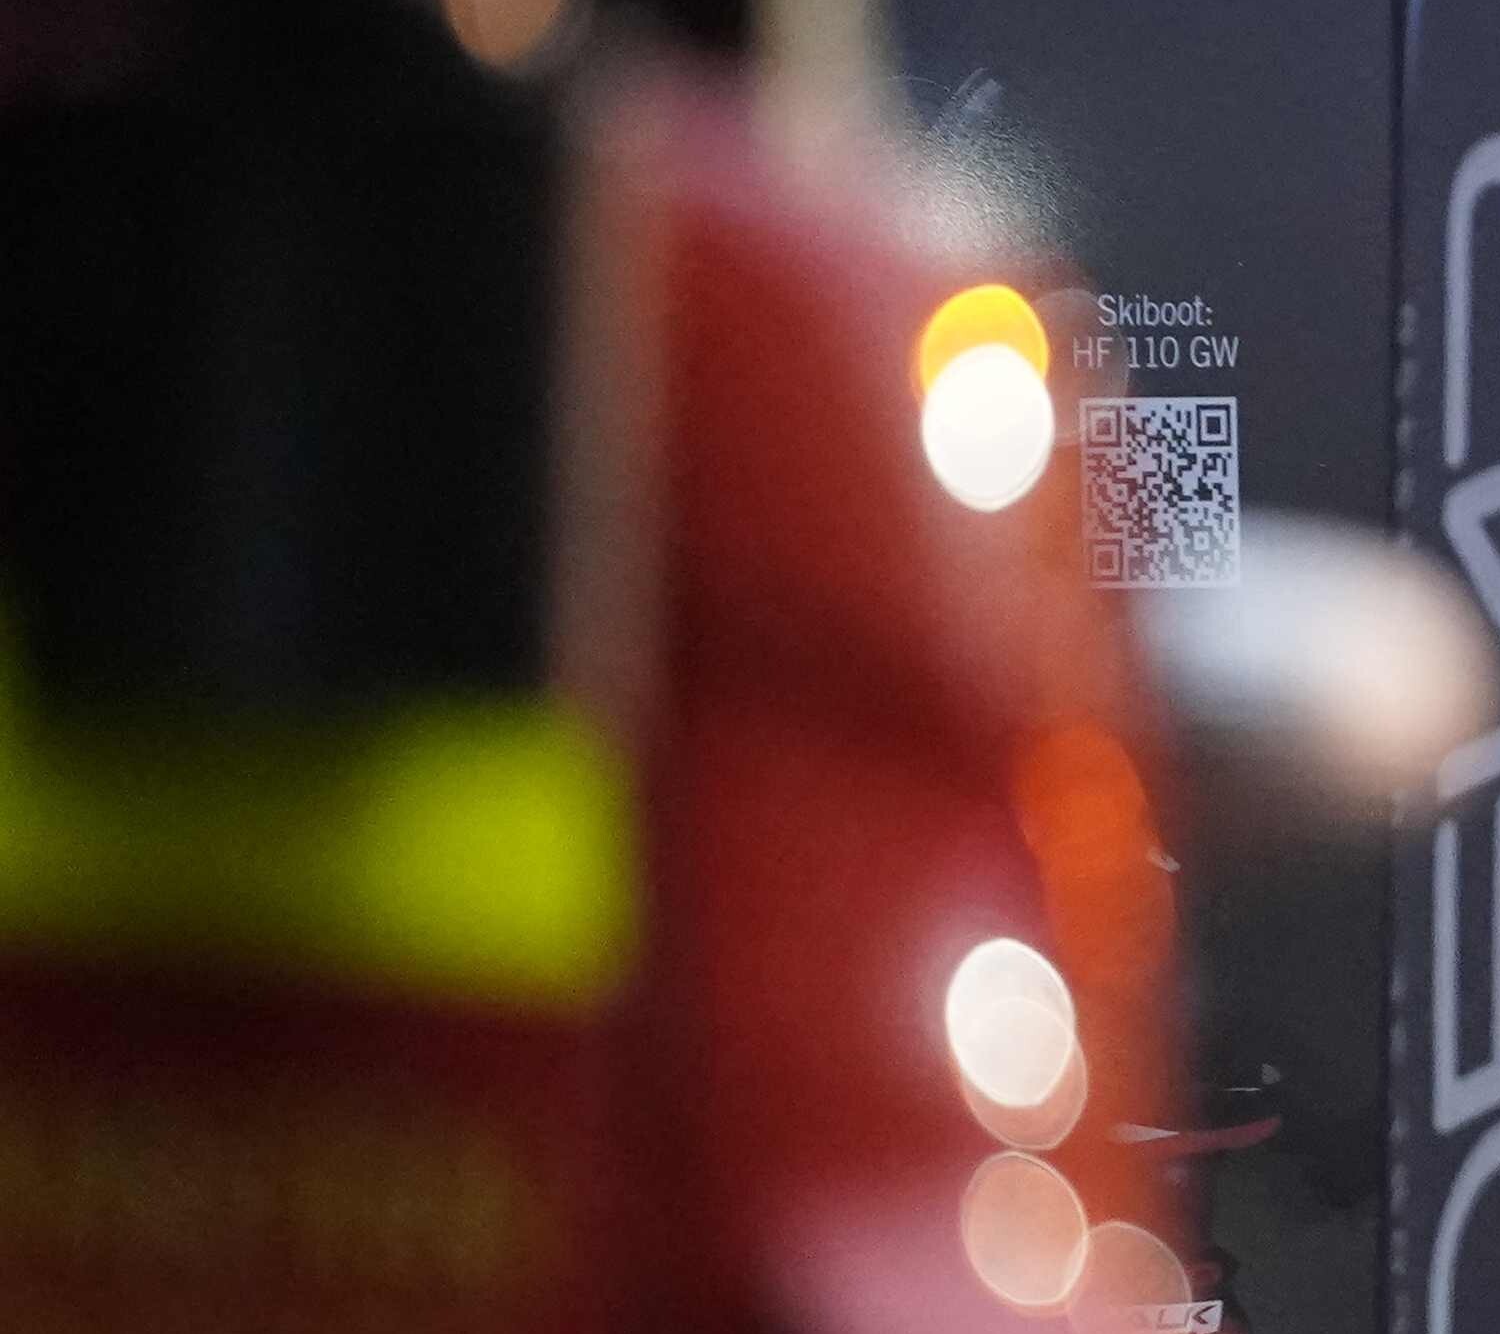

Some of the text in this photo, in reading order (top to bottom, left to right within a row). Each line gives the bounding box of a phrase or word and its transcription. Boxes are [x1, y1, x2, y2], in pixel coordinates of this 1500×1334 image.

[1099, 294, 1212, 326] Skiboot:
[1073, 335, 1240, 368] HF 110 GW
